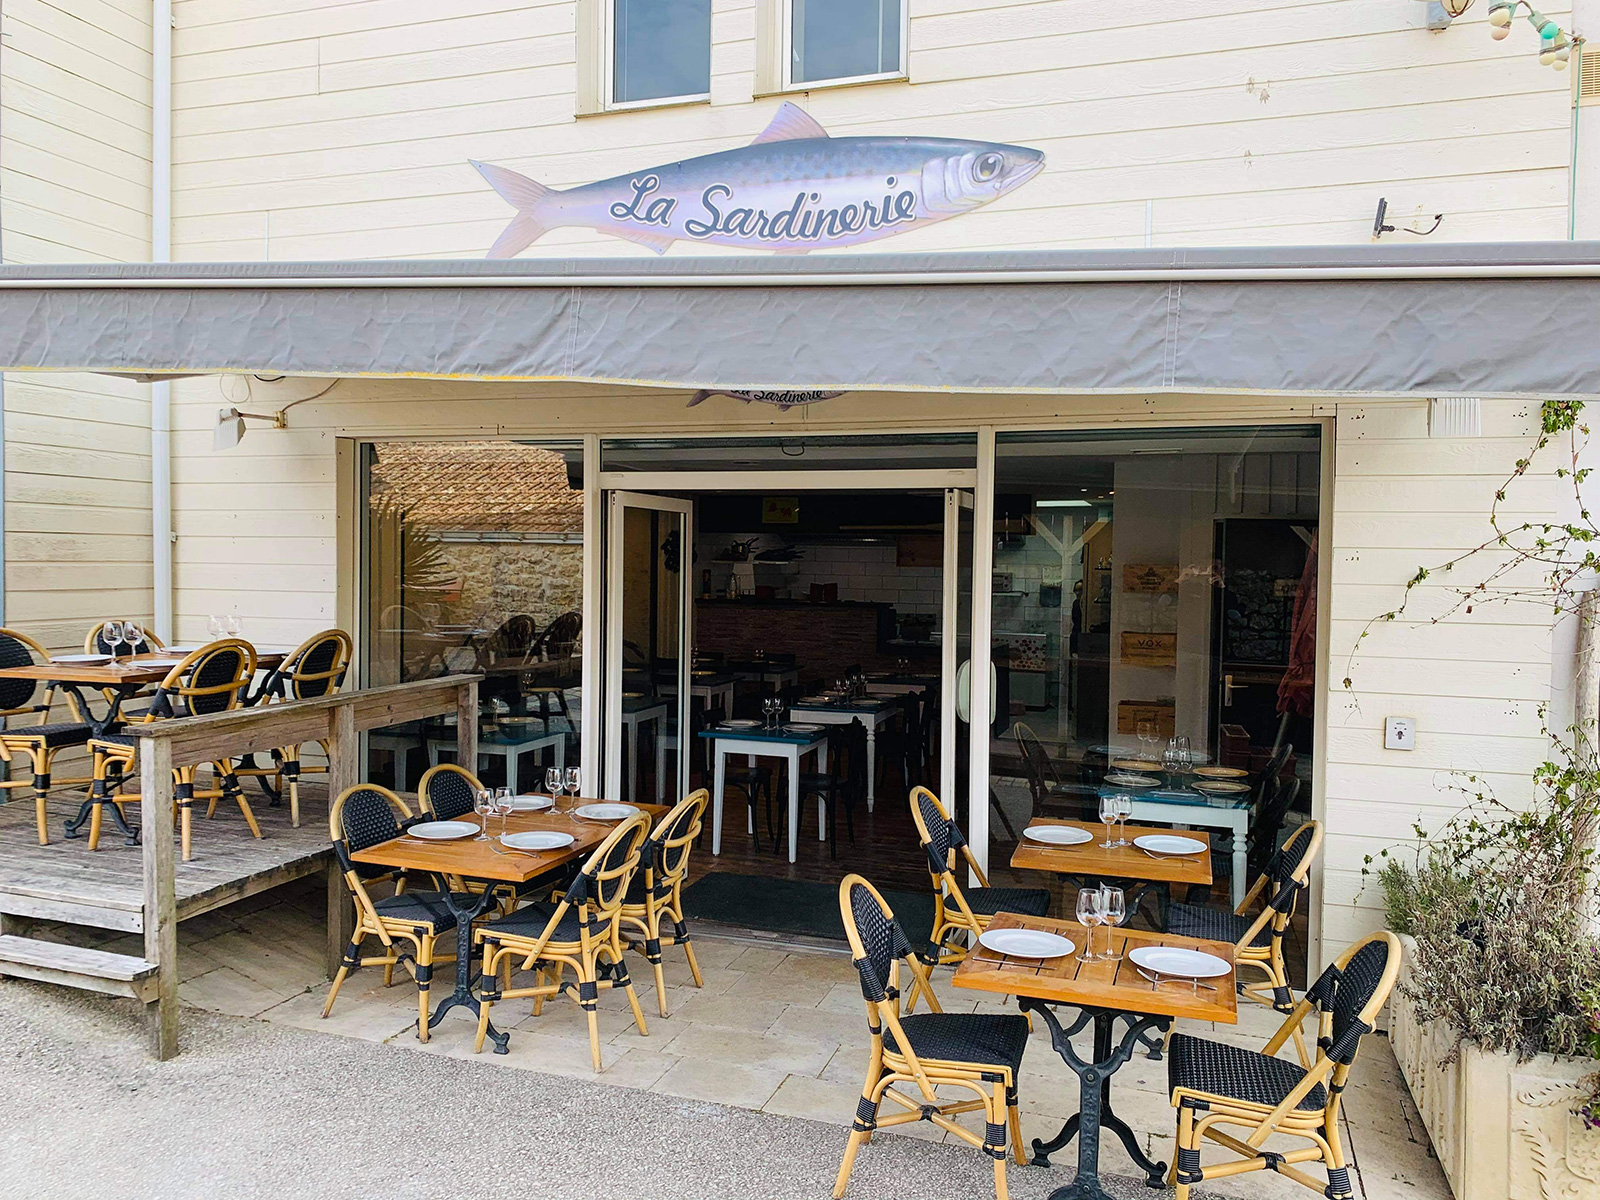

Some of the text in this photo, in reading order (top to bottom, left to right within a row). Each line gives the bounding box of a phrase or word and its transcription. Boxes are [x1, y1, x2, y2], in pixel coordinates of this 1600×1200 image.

[609, 174, 916, 240] La Sardinerie
[1137, 639, 1162, 648] VOX
